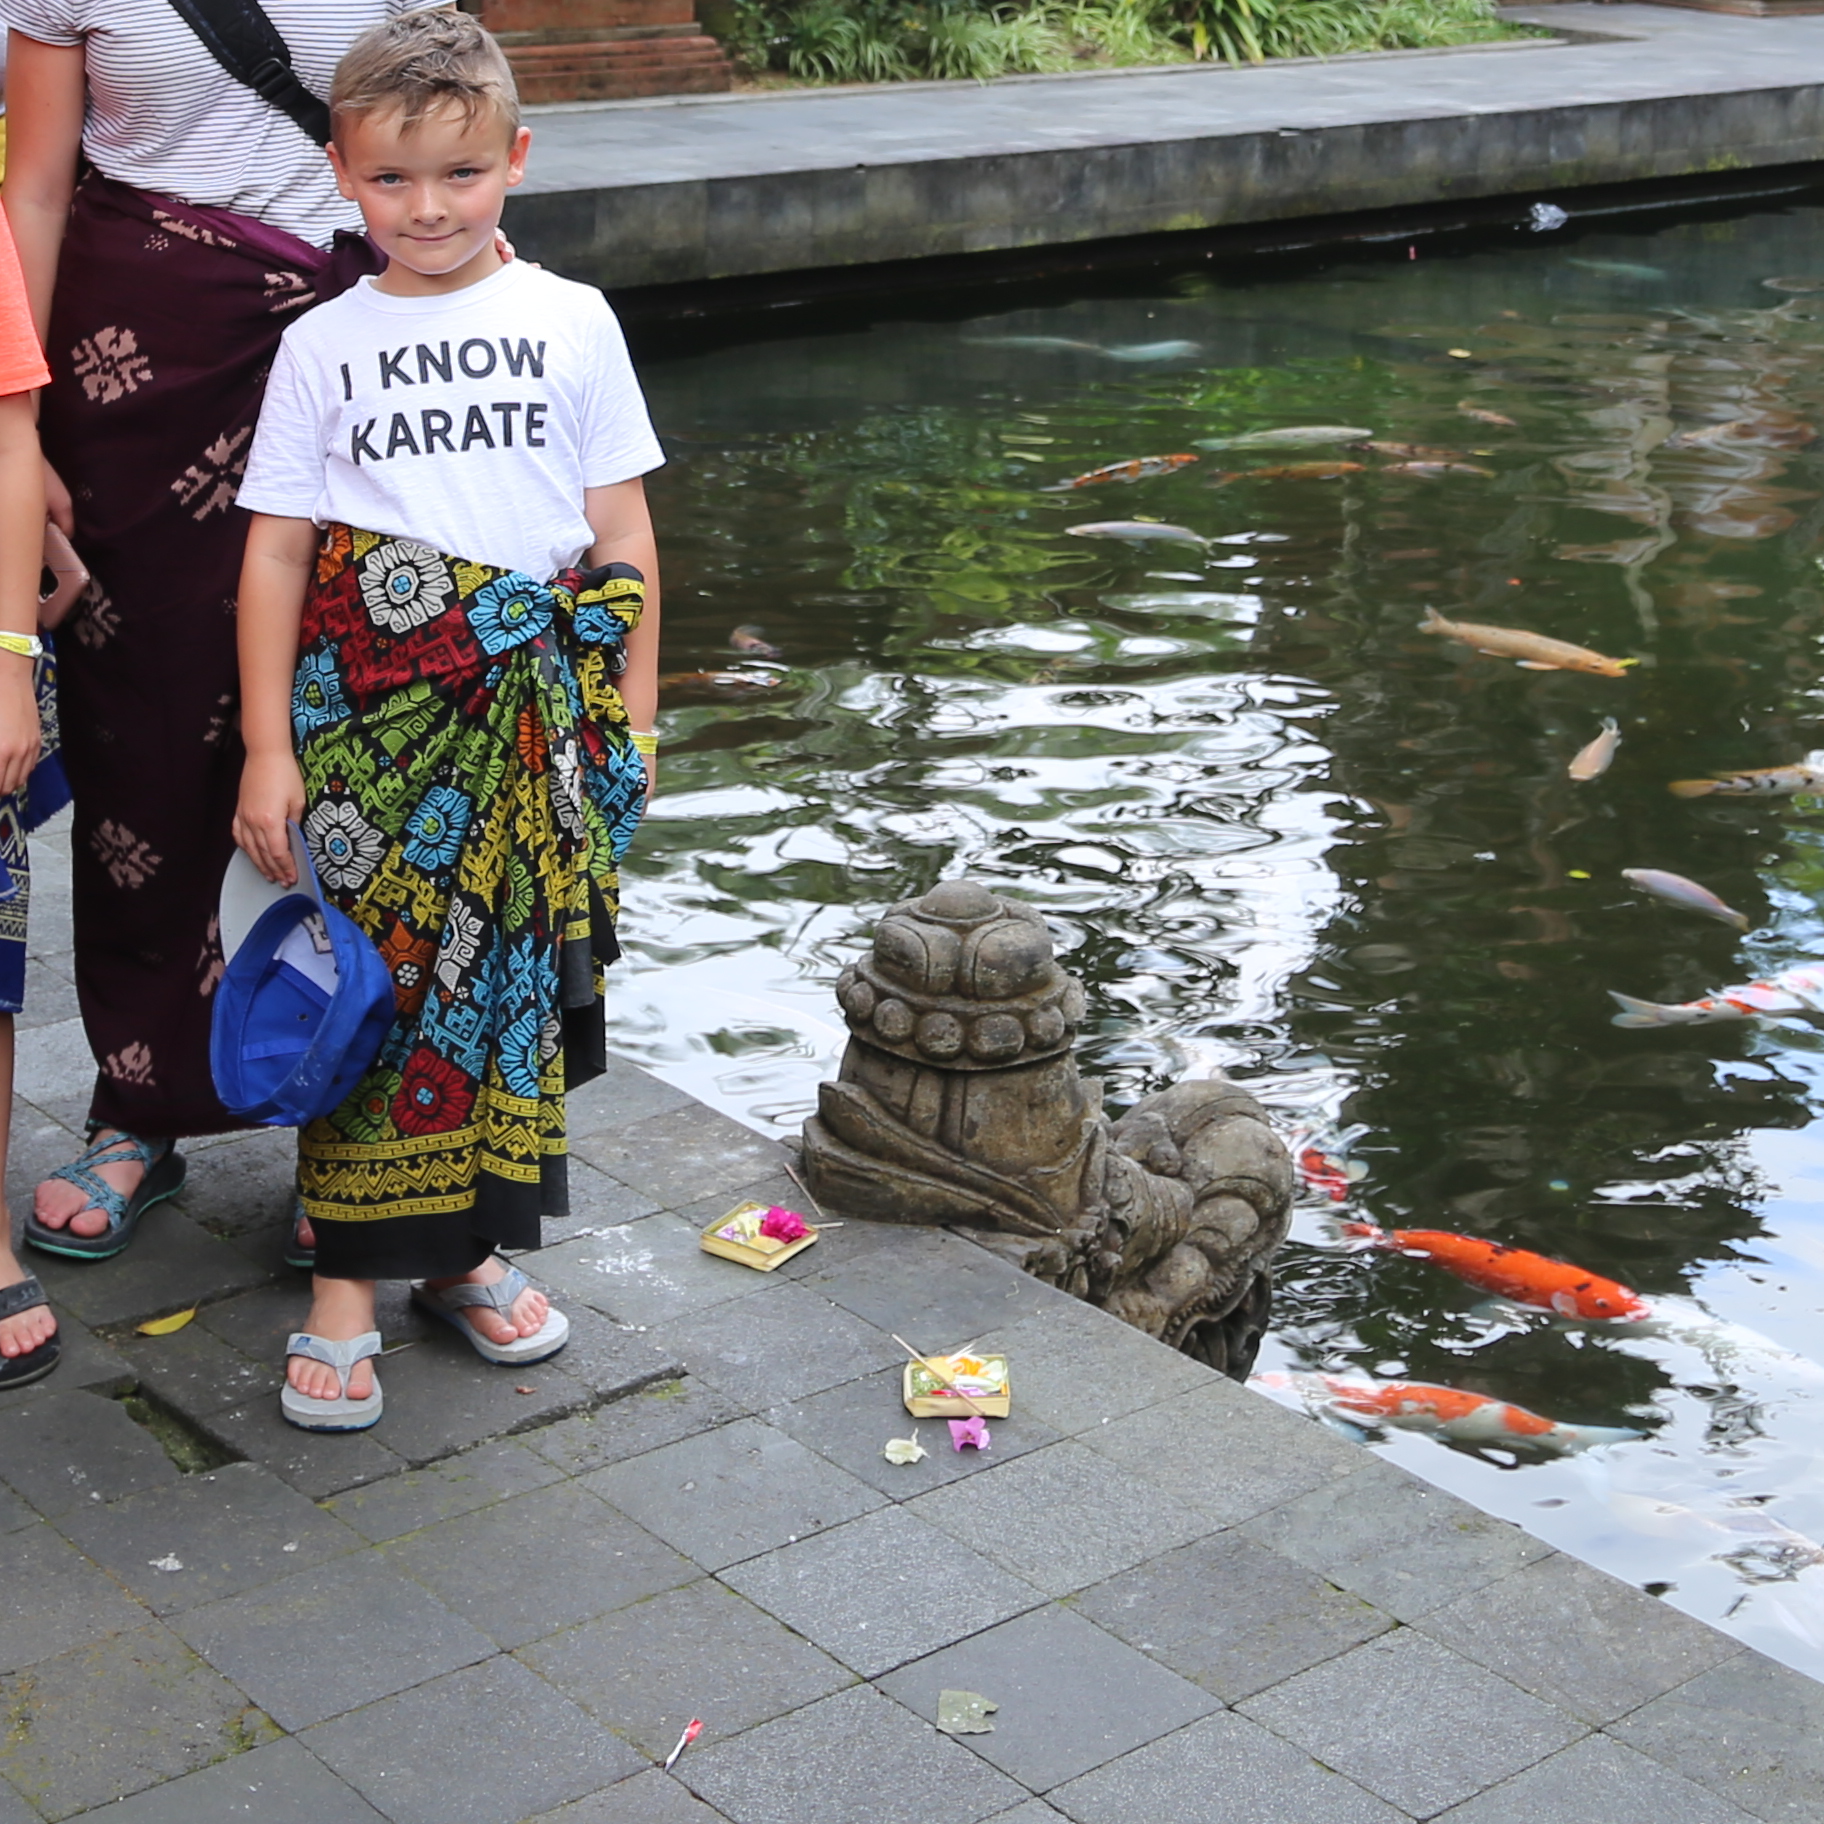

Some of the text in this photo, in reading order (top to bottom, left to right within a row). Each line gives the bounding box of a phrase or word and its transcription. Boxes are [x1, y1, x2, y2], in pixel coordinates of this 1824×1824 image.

[340, 337, 547, 401] I KNOW
[351, 402, 548, 466] KARATE
